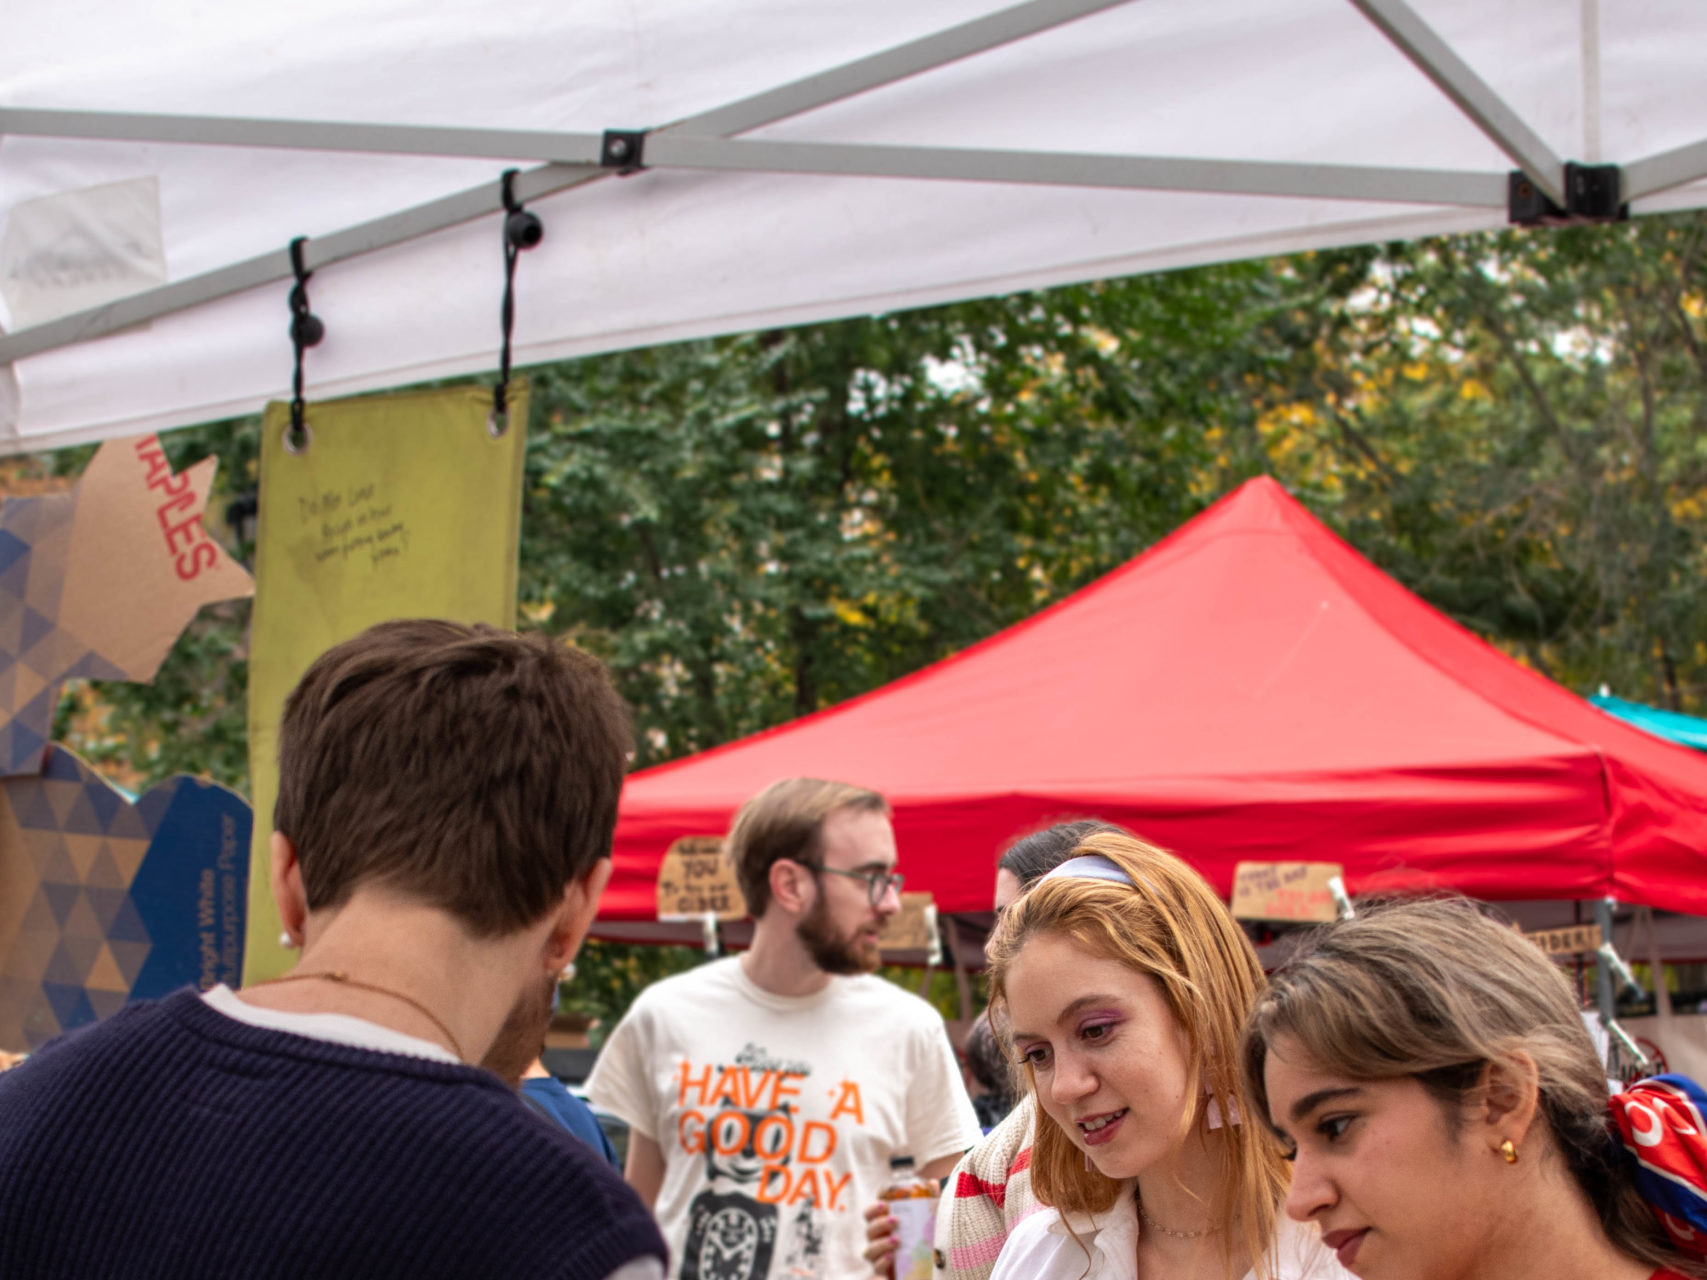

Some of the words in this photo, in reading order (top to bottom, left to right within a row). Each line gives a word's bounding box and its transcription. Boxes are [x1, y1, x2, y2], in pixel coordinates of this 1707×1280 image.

[218, 813, 238, 870] Paper
[681, 859, 719, 879] YOU
[198, 868, 215, 927] White
[679, 1060, 806, 1114] HAVE
[829, 1080, 865, 1126] A
[678, 1109, 838, 1164] GOOD
